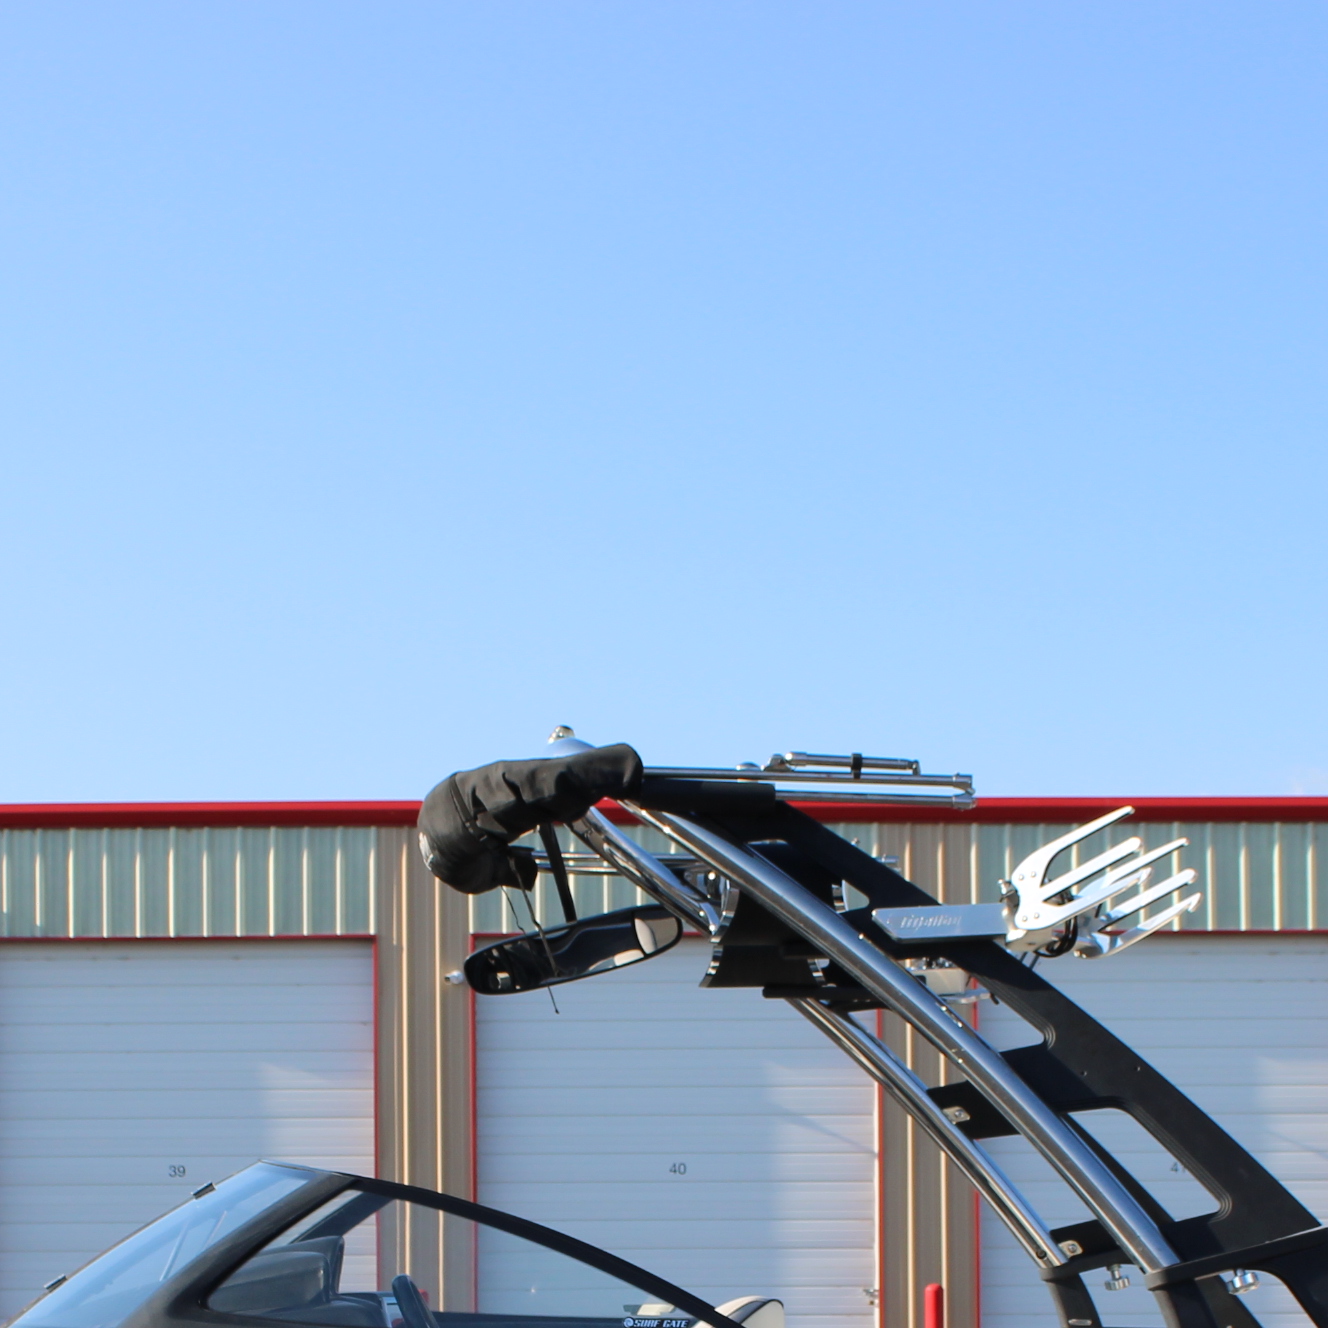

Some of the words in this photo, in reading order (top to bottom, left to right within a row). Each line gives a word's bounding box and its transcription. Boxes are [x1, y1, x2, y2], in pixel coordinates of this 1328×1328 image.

[168, 1164, 186, 1178] 39
[669, 1162, 687, 1176] 40
[634, 1319, 660, 1328] SURF
[663, 1319, 688, 1328] GATE
